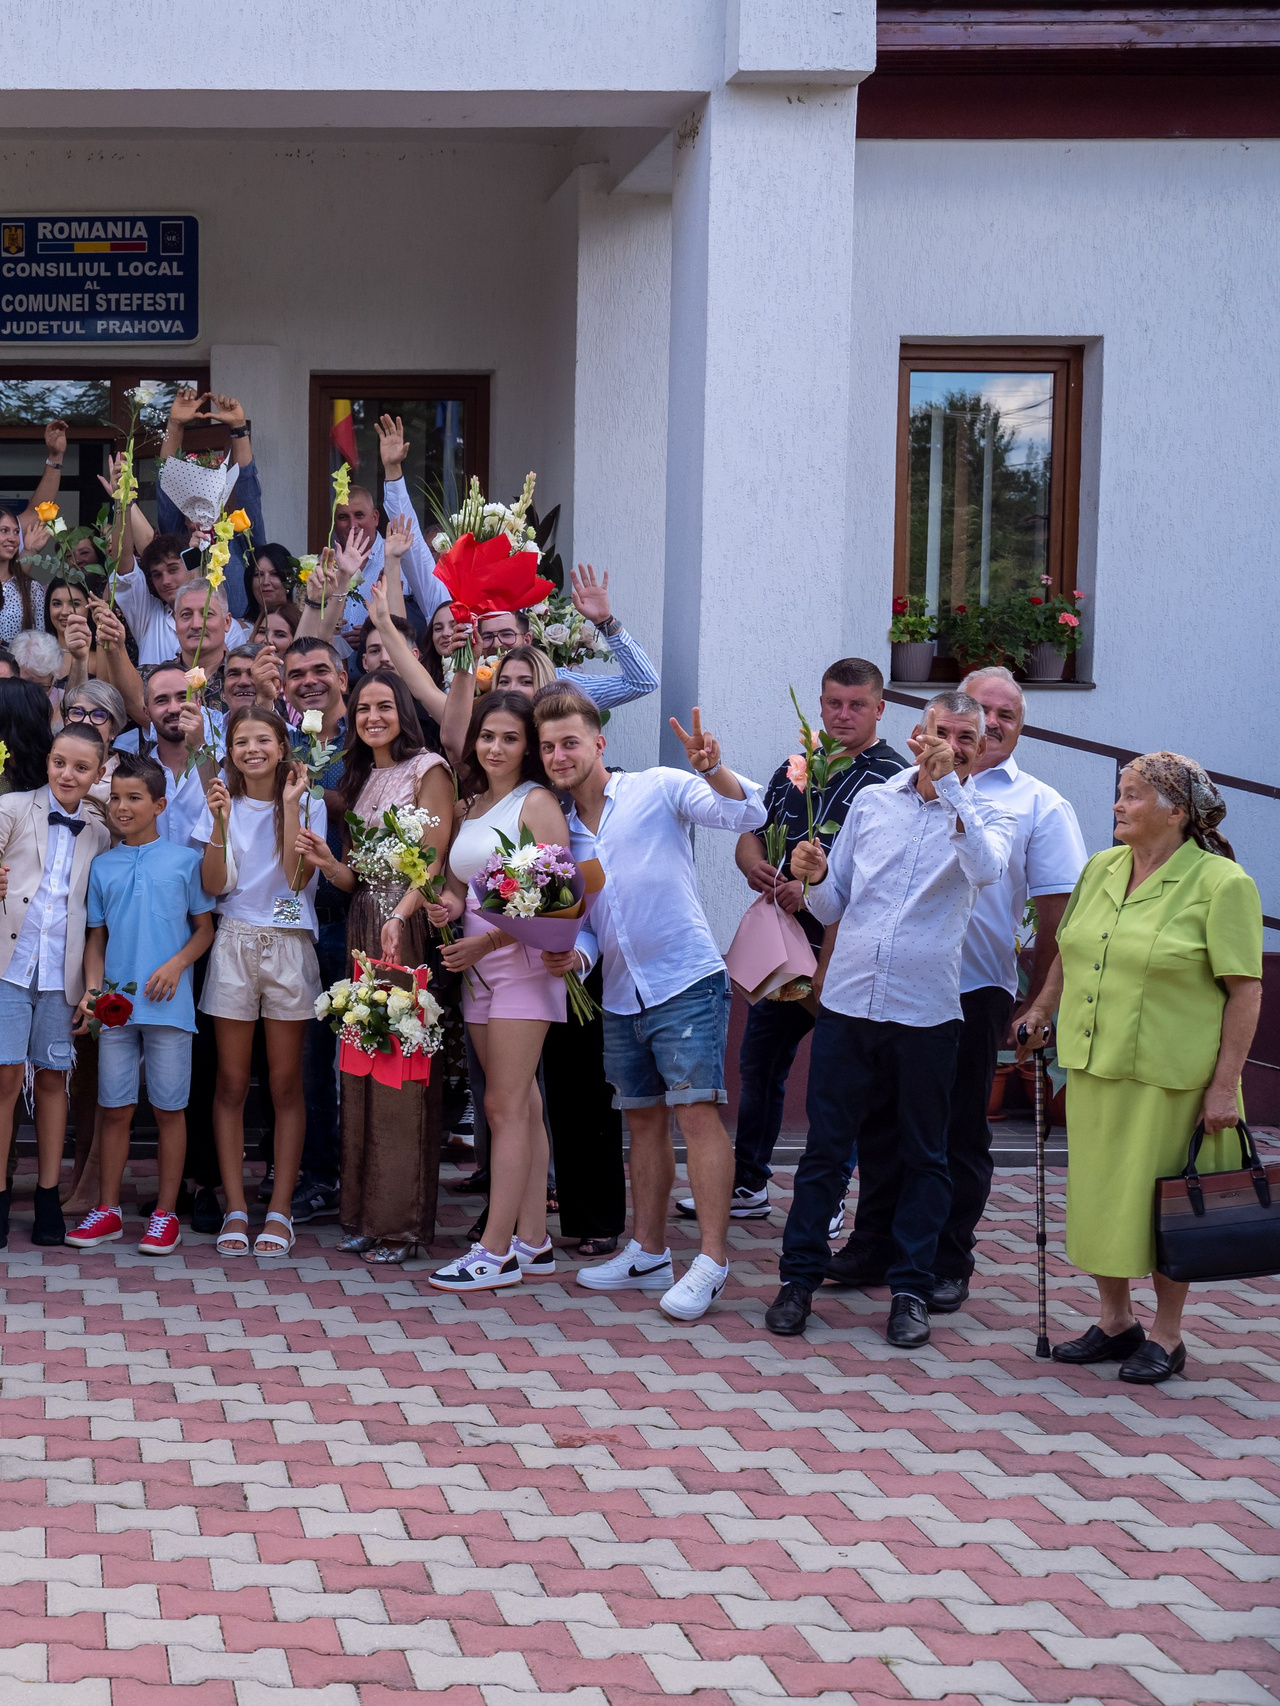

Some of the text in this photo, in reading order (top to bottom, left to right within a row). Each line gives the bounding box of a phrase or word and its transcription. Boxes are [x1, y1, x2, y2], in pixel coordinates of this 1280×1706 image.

[37, 220, 149, 240] ROMANIA
[1, 261, 184, 278] CONSILIUL LOCAL
[84, 280, 101, 290] AL
[1, 292, 185, 313] COMUNEI STEFESTI
[0, 319, 185, 335] JUDETUL PRAHOVA
